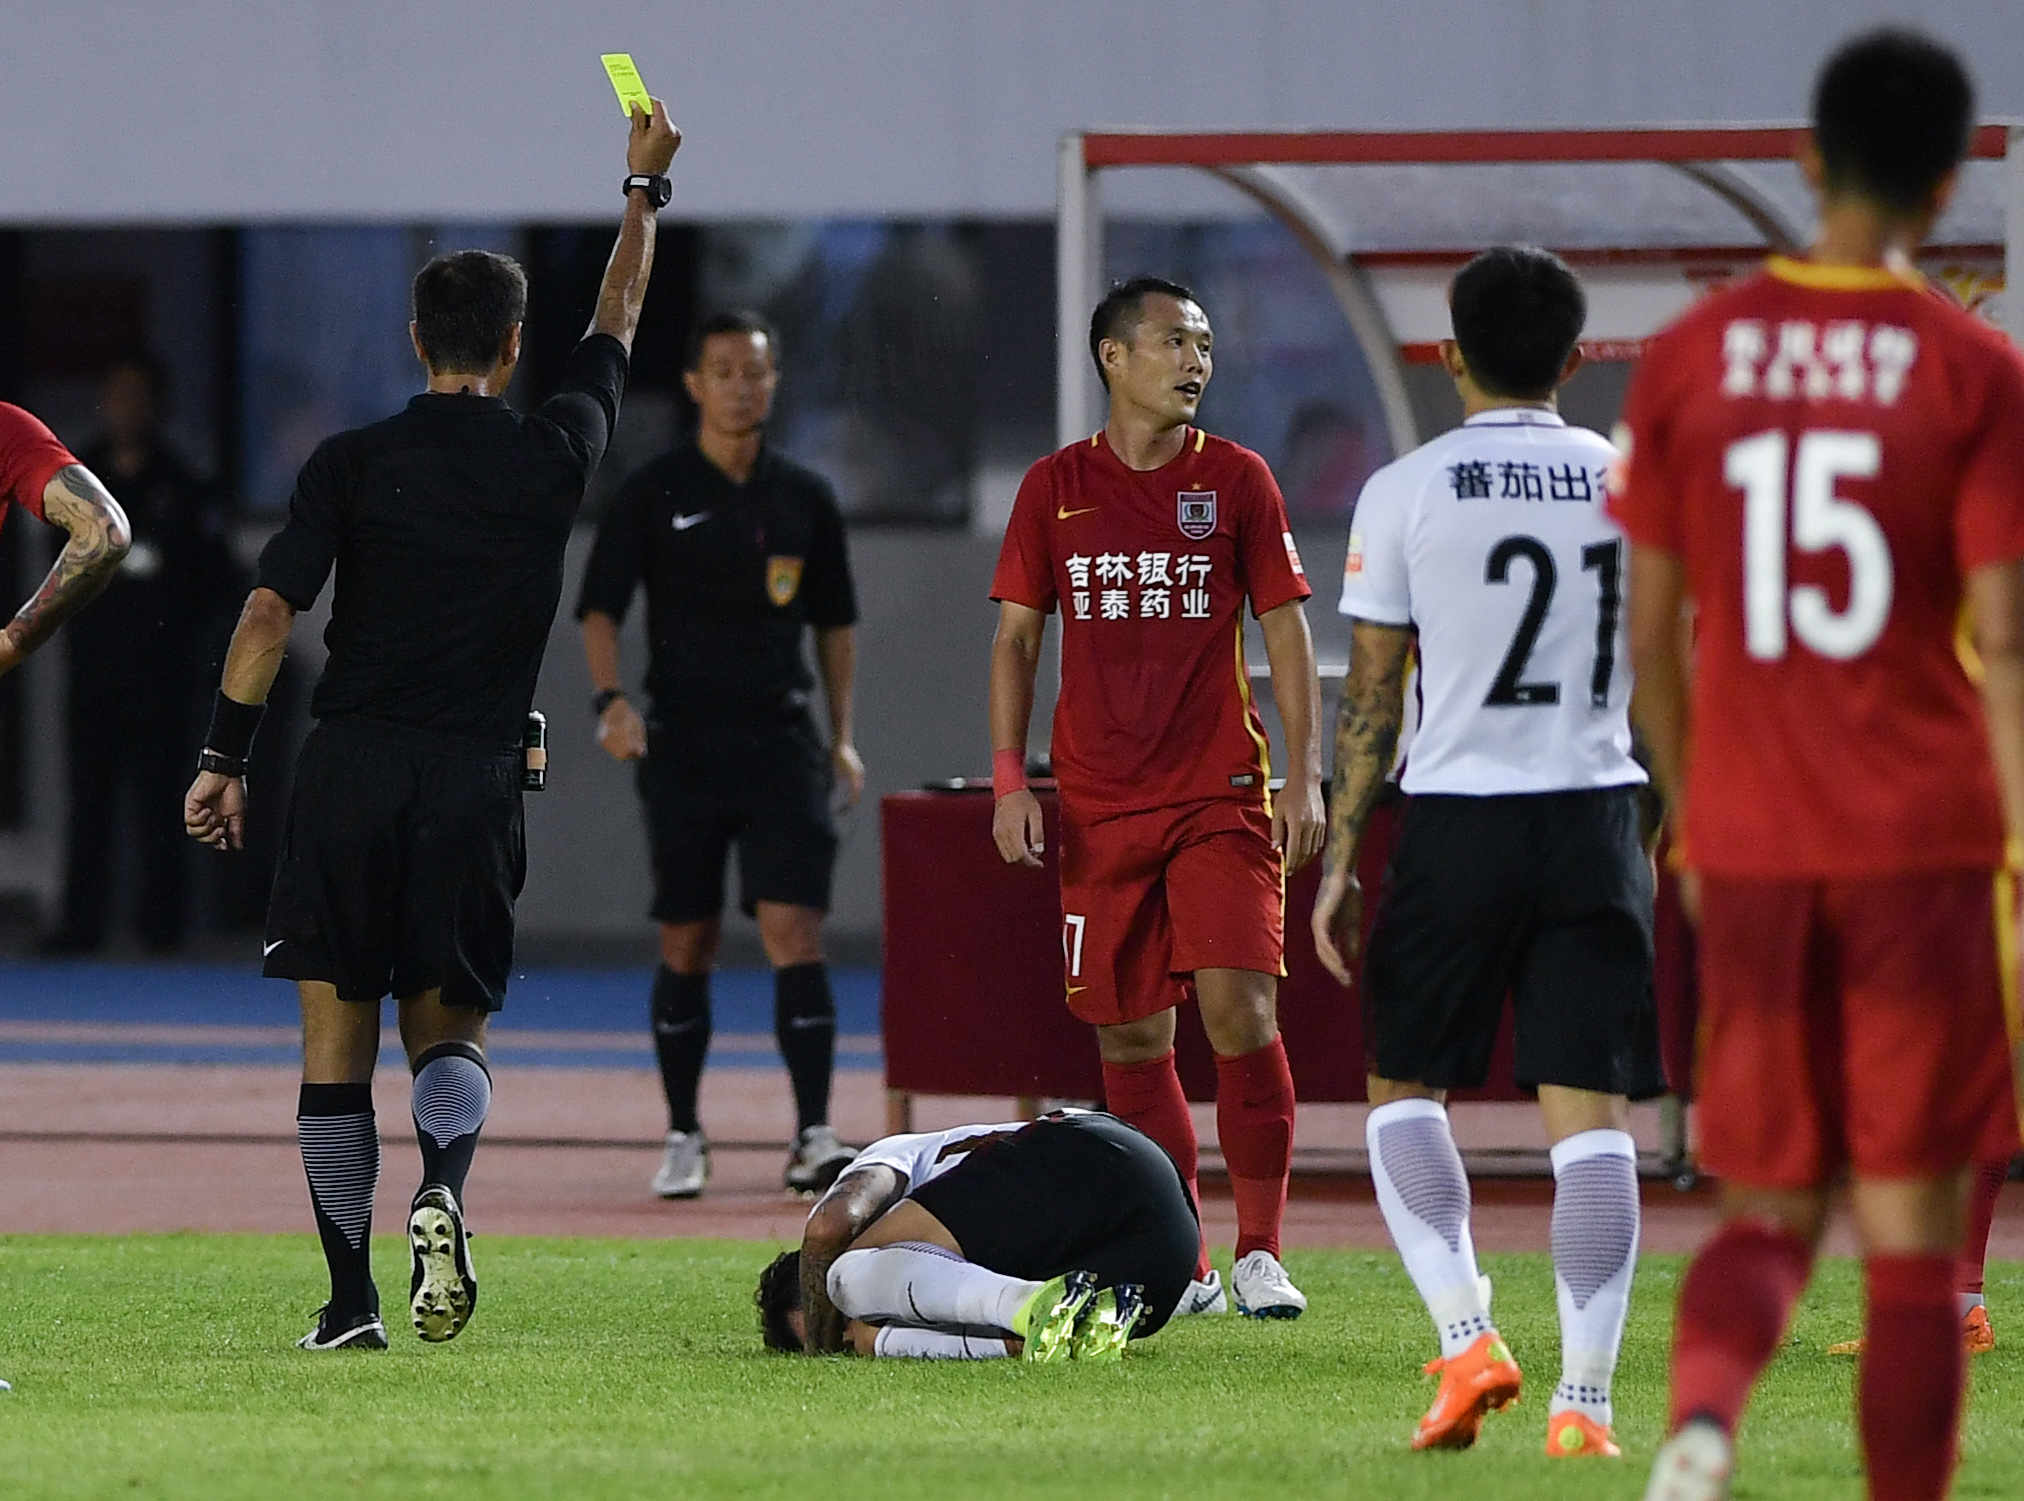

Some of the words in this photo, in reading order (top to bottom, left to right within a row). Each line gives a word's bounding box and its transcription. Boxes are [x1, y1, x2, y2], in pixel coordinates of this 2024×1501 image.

[1448, 459, 1608, 502] 蕃茄出
[1722, 428, 1896, 662] 15
[1065, 550, 1213, 587] 吉林银行
[1072, 588, 1211, 620] 亚泰药业
[1482, 533, 1622, 709] 21
